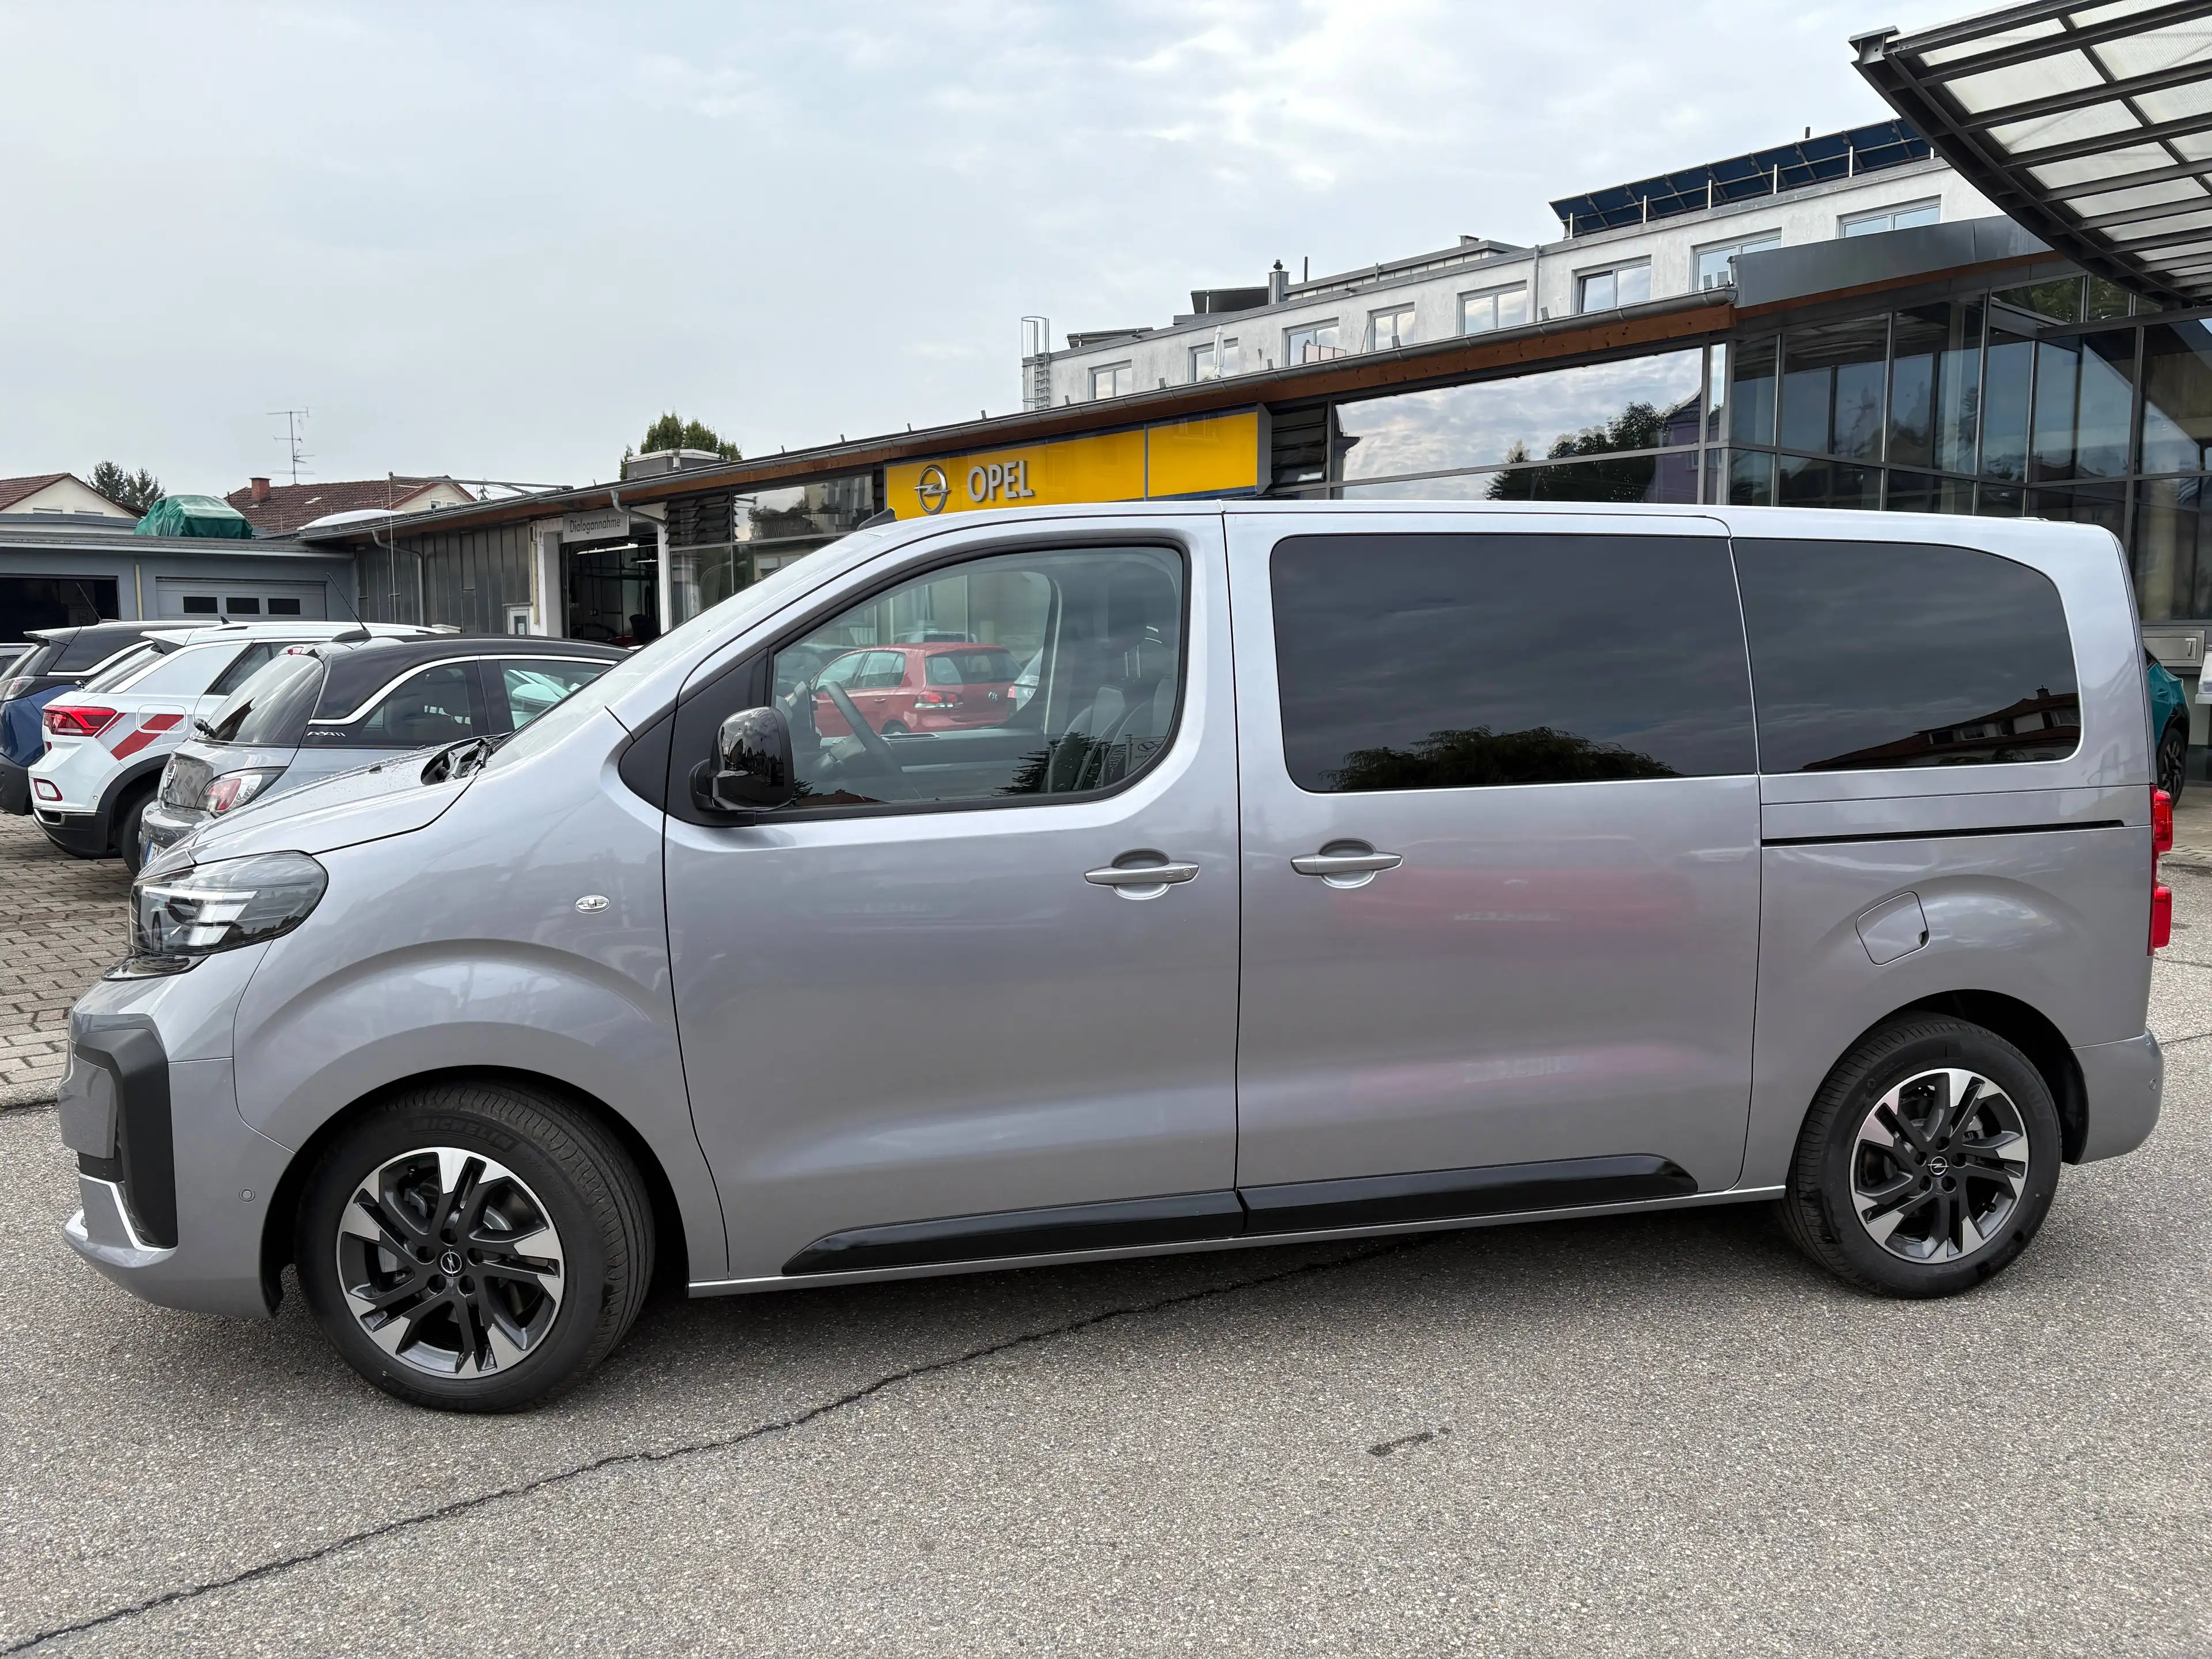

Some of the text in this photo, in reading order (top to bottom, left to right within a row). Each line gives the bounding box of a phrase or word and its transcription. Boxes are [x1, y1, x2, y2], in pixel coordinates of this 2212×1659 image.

[967, 460, 1035, 502] OPEL
[570, 514, 621, 535] Dialogannahme
[411, 1118, 515, 1150] MICHELIN
